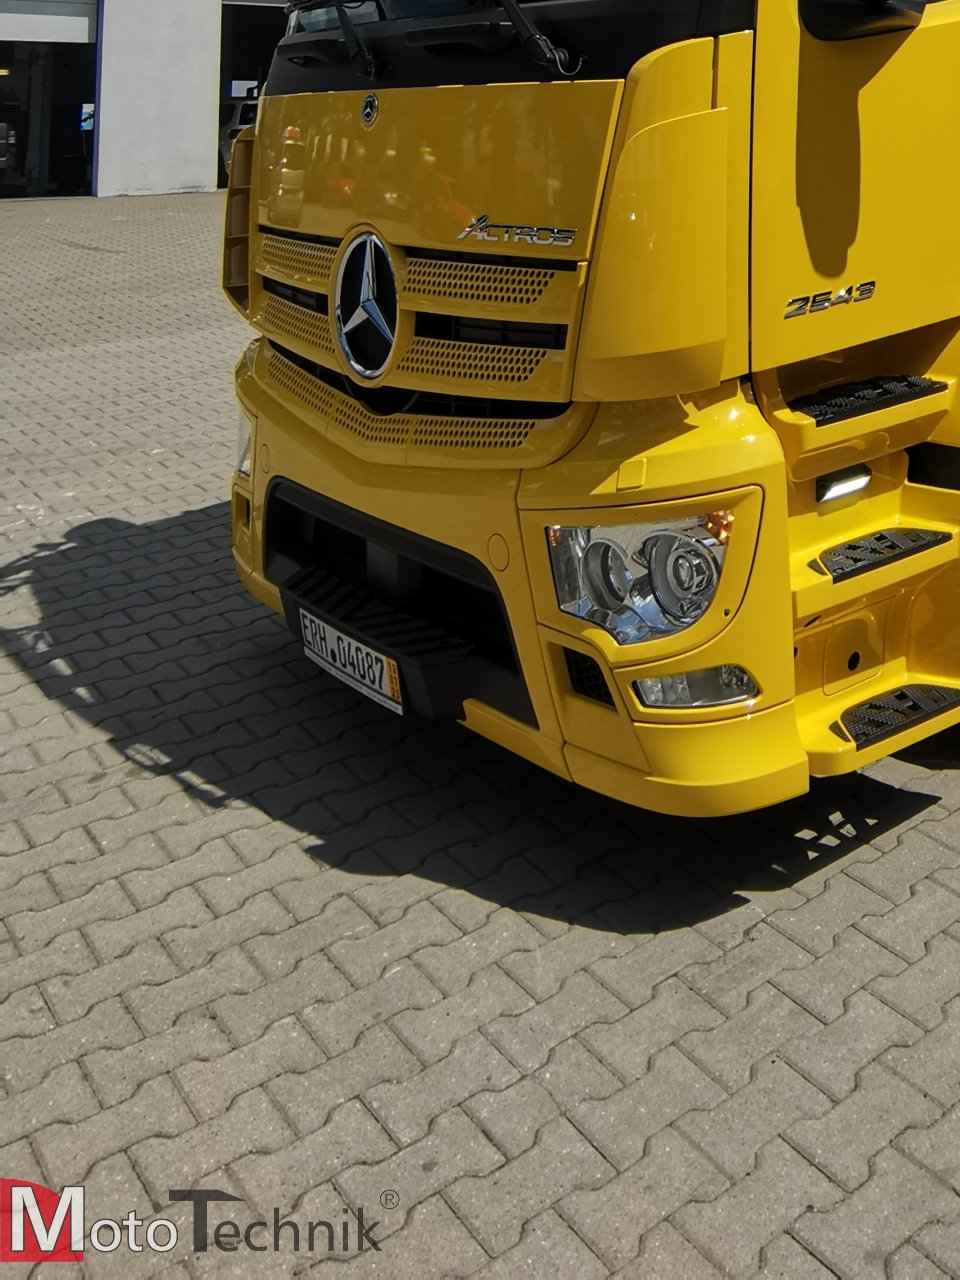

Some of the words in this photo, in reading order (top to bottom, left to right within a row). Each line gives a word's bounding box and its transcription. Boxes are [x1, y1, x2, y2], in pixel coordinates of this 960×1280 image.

[457, 214, 577, 247] ACTROS
[784, 280, 876, 320] 2543
[301, 611, 329, 659] ERH
[336, 634, 385, 691] 04087
